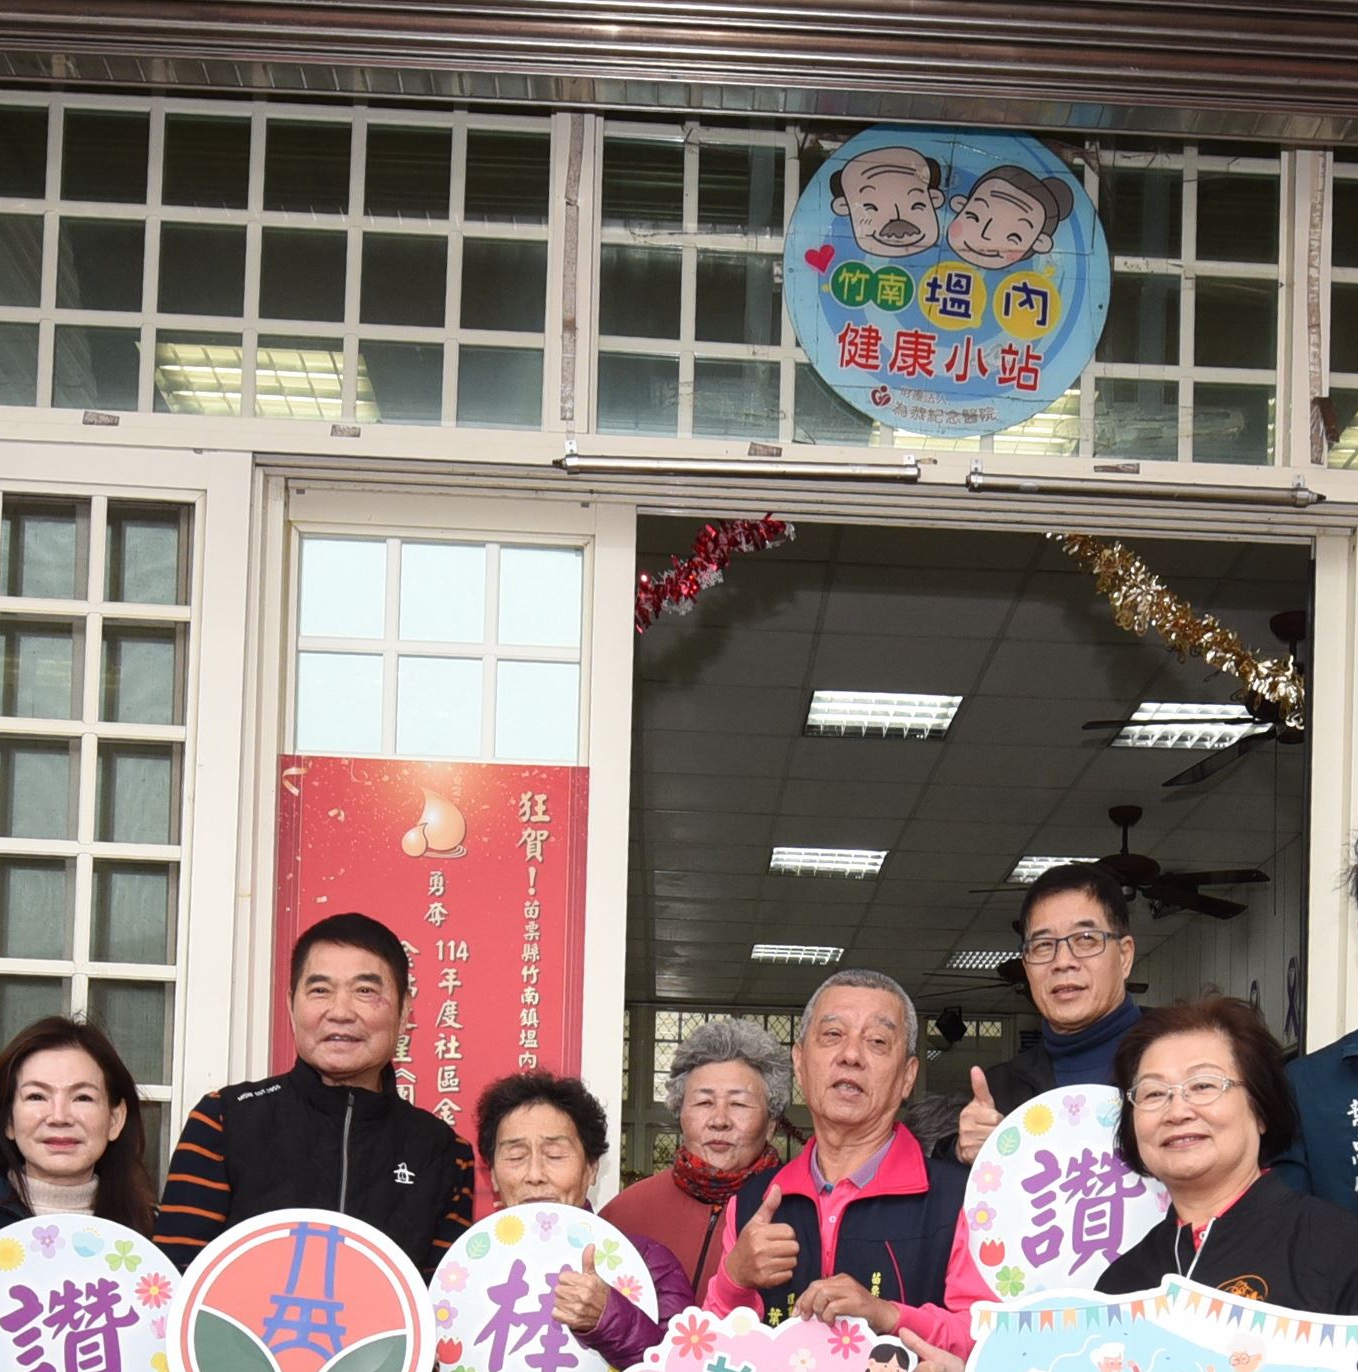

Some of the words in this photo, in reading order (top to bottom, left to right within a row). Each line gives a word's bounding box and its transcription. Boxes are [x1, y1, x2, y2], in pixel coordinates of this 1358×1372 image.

[838, 268, 906, 308] 竹南
[837, 322, 1043, 393] 健康小站
[423, 870, 450, 927] 勇奪
[1020, 1149, 1148, 1277] 讚
